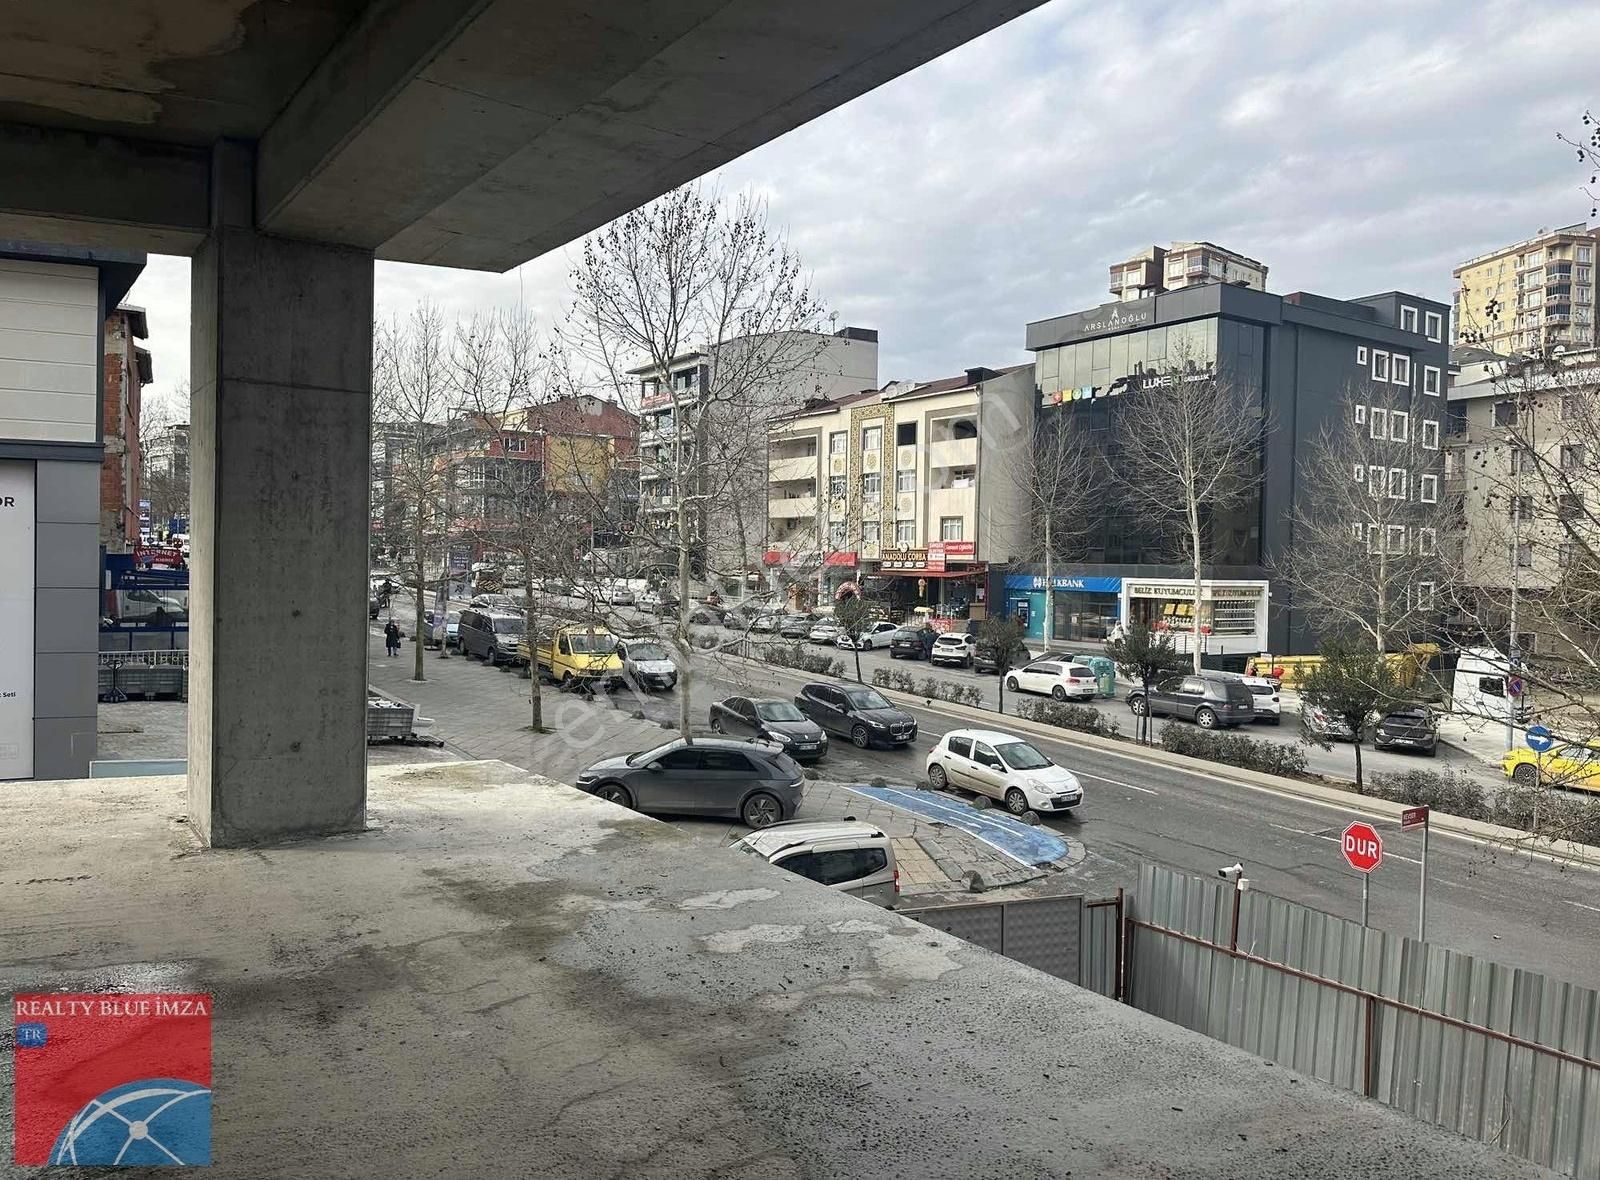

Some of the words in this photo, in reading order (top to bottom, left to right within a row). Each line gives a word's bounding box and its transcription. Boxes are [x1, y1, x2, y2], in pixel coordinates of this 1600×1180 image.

[1084, 312, 1147, 332] ARSLANOĞLU
[882, 552, 907, 561] ANADOLU
[1042, 578, 1084, 588] HLKBANK
[1345, 835, 1378, 859] DUR
